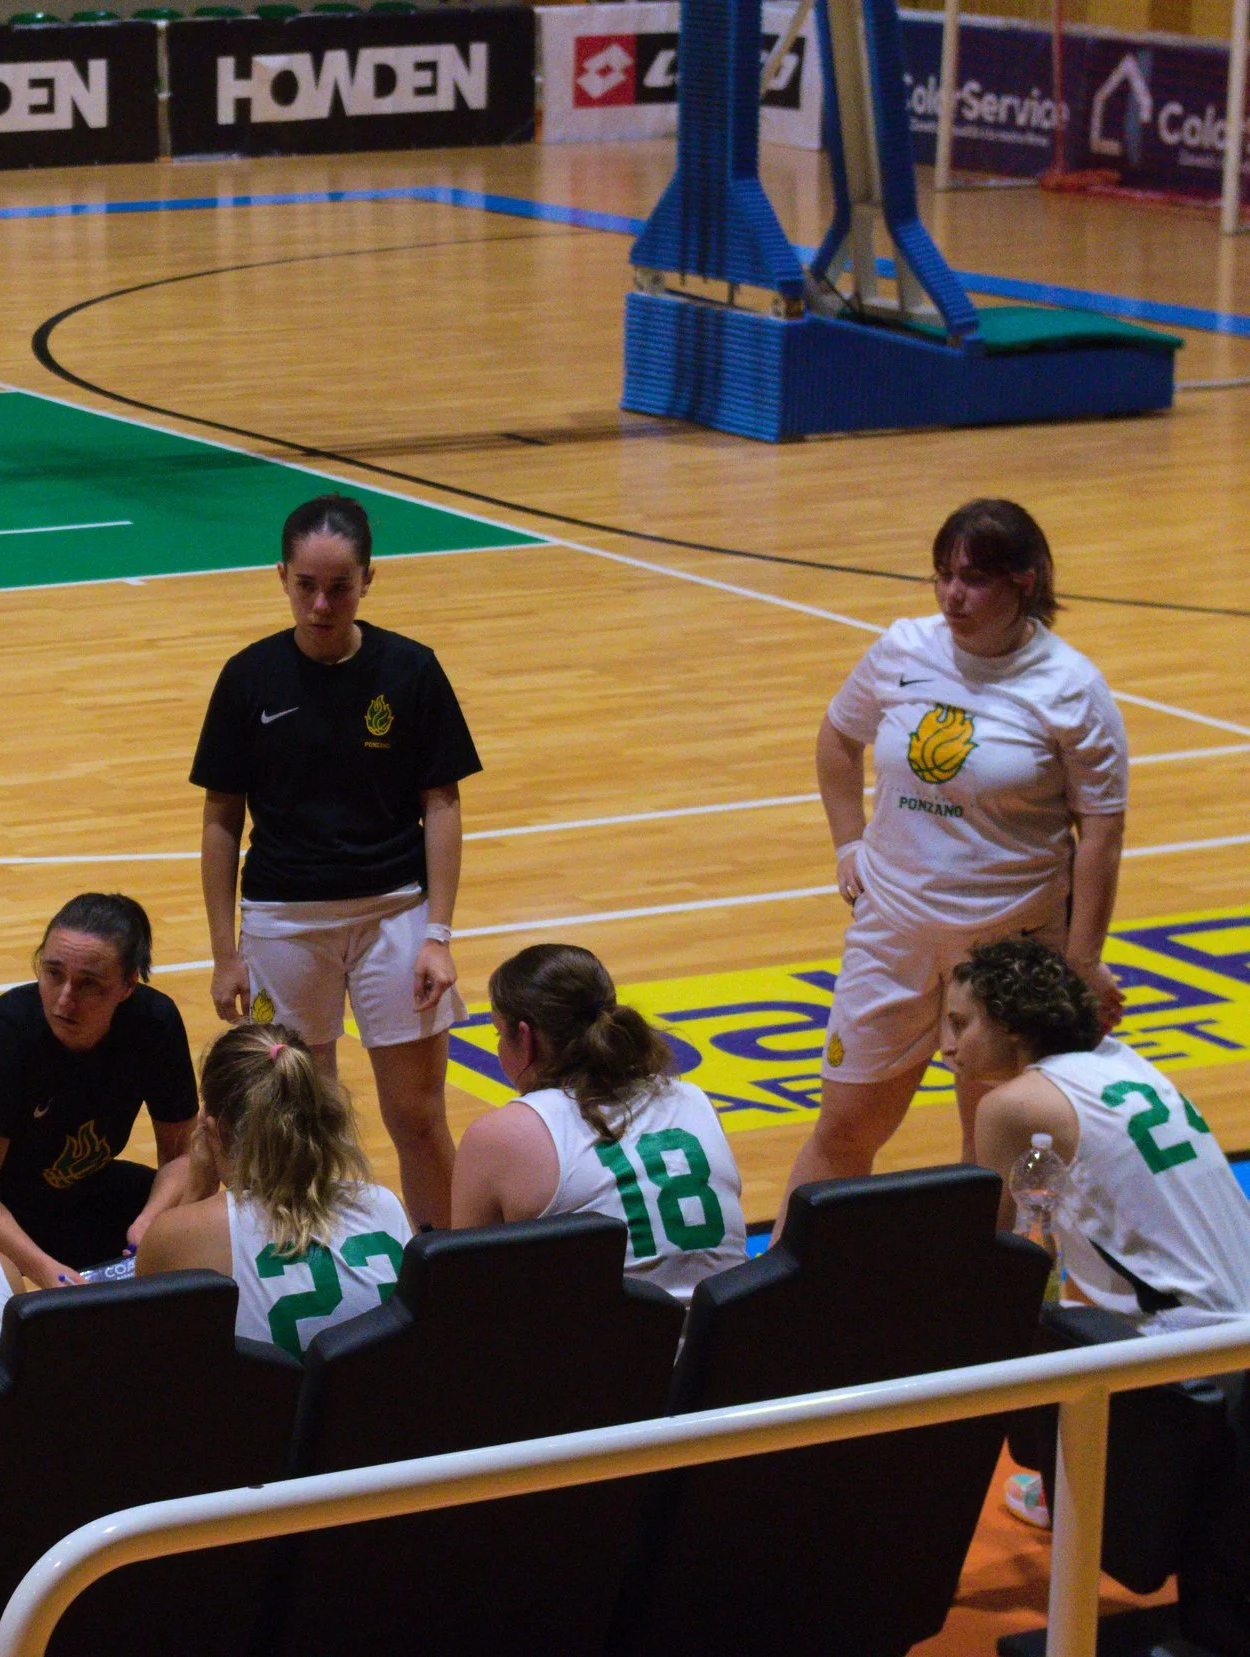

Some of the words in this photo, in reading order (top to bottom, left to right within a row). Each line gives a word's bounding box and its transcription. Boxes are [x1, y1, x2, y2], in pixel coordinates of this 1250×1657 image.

[216, 42, 487, 125] HOWDEN
[899, 796, 964, 817] PONZANO
[593, 1127, 725, 1258] 18
